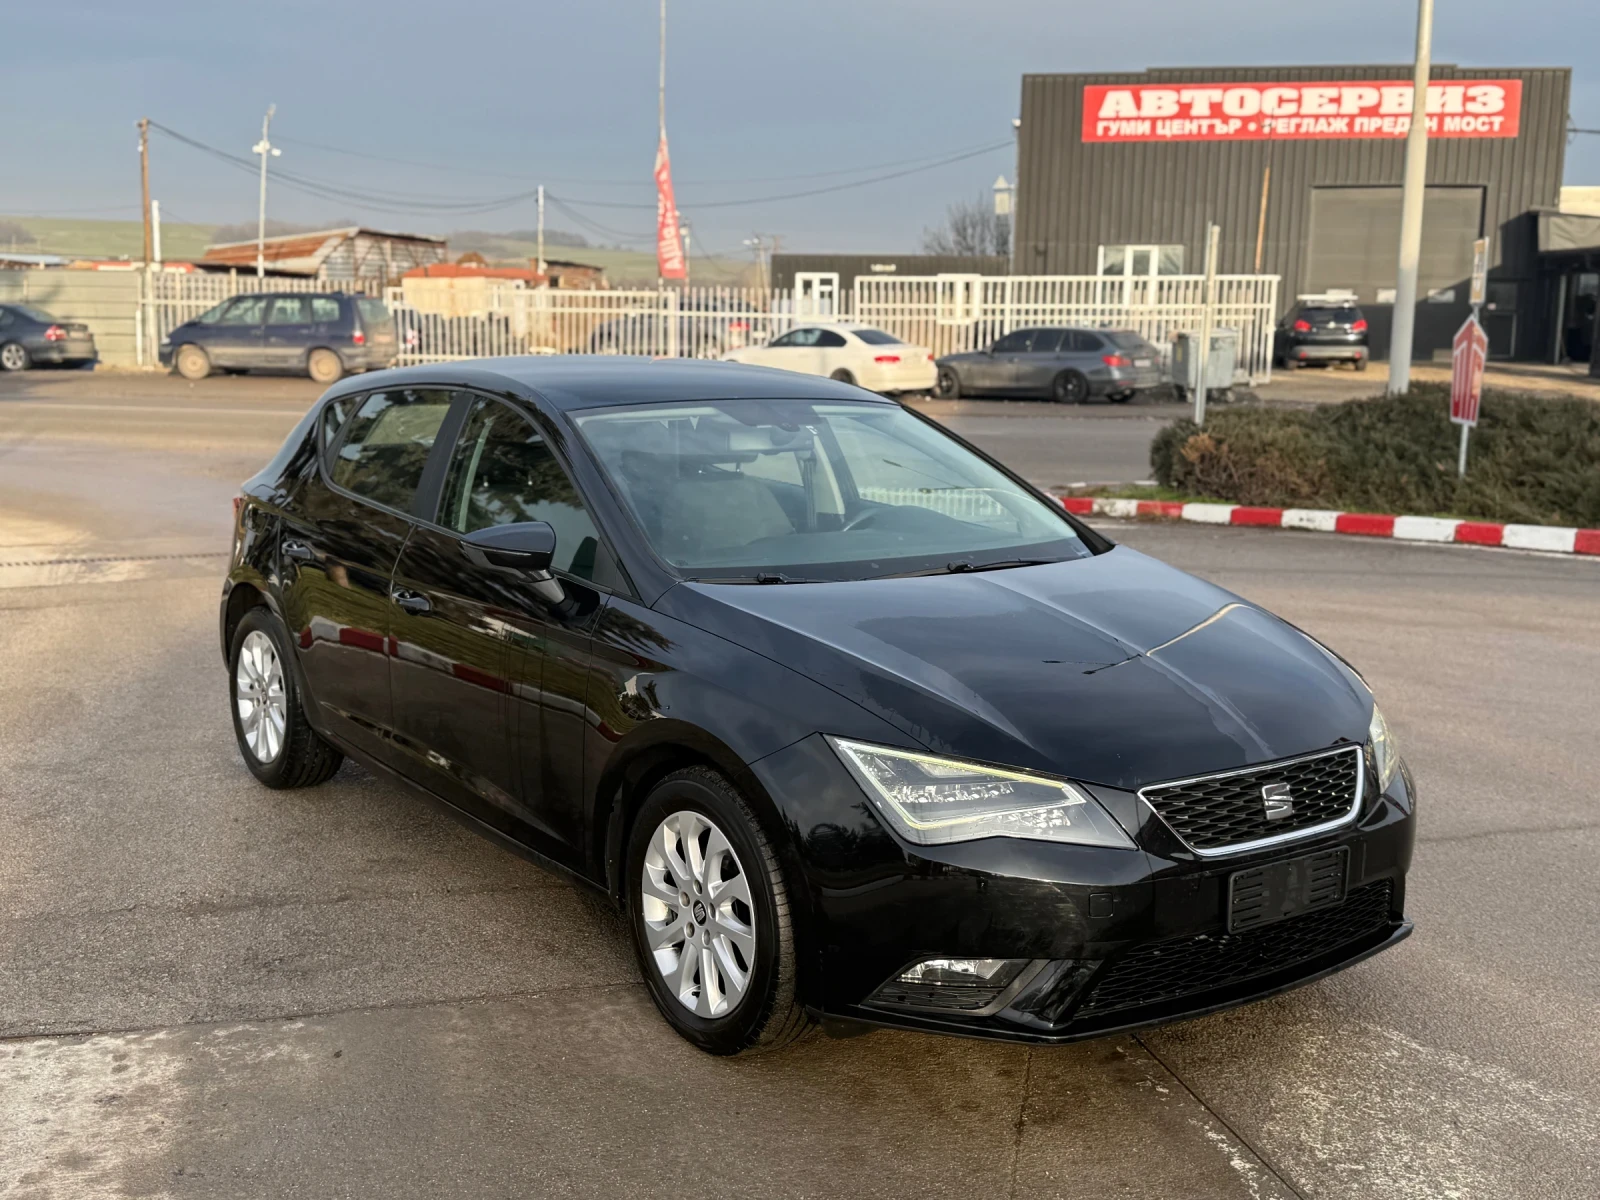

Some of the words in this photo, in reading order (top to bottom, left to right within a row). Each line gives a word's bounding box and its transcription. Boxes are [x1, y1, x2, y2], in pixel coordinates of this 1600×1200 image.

[1098, 85, 1506, 118] АВТОСЕРВИЗ
[1097, 119, 1151, 136] ГУМИ
[1156, 118, 1242, 138] ЦЕНТЪР
[1354, 116, 1438, 134] ПРЕДН
[1443, 115, 1505, 132] МОСТ
